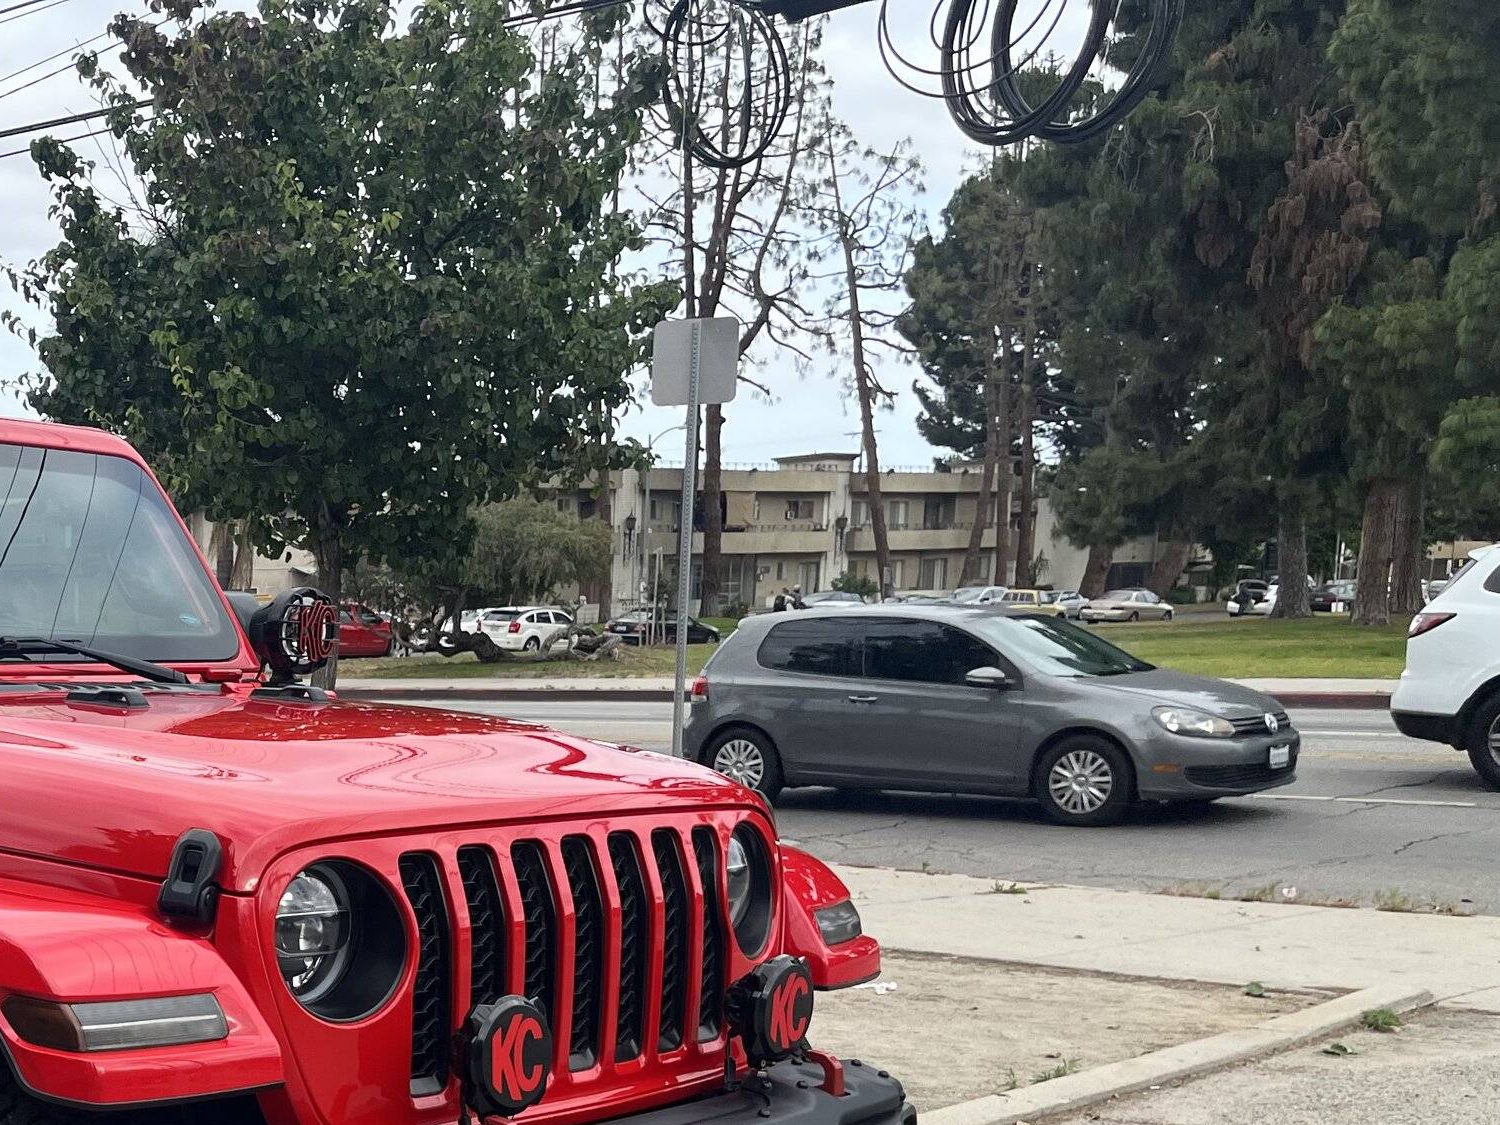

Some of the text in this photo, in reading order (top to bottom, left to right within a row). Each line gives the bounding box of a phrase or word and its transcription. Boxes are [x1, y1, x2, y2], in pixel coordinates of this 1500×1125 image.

[299, 600, 338, 662] KC
[770, 972, 809, 1049] KC
[492, 1013, 543, 1101] KC
